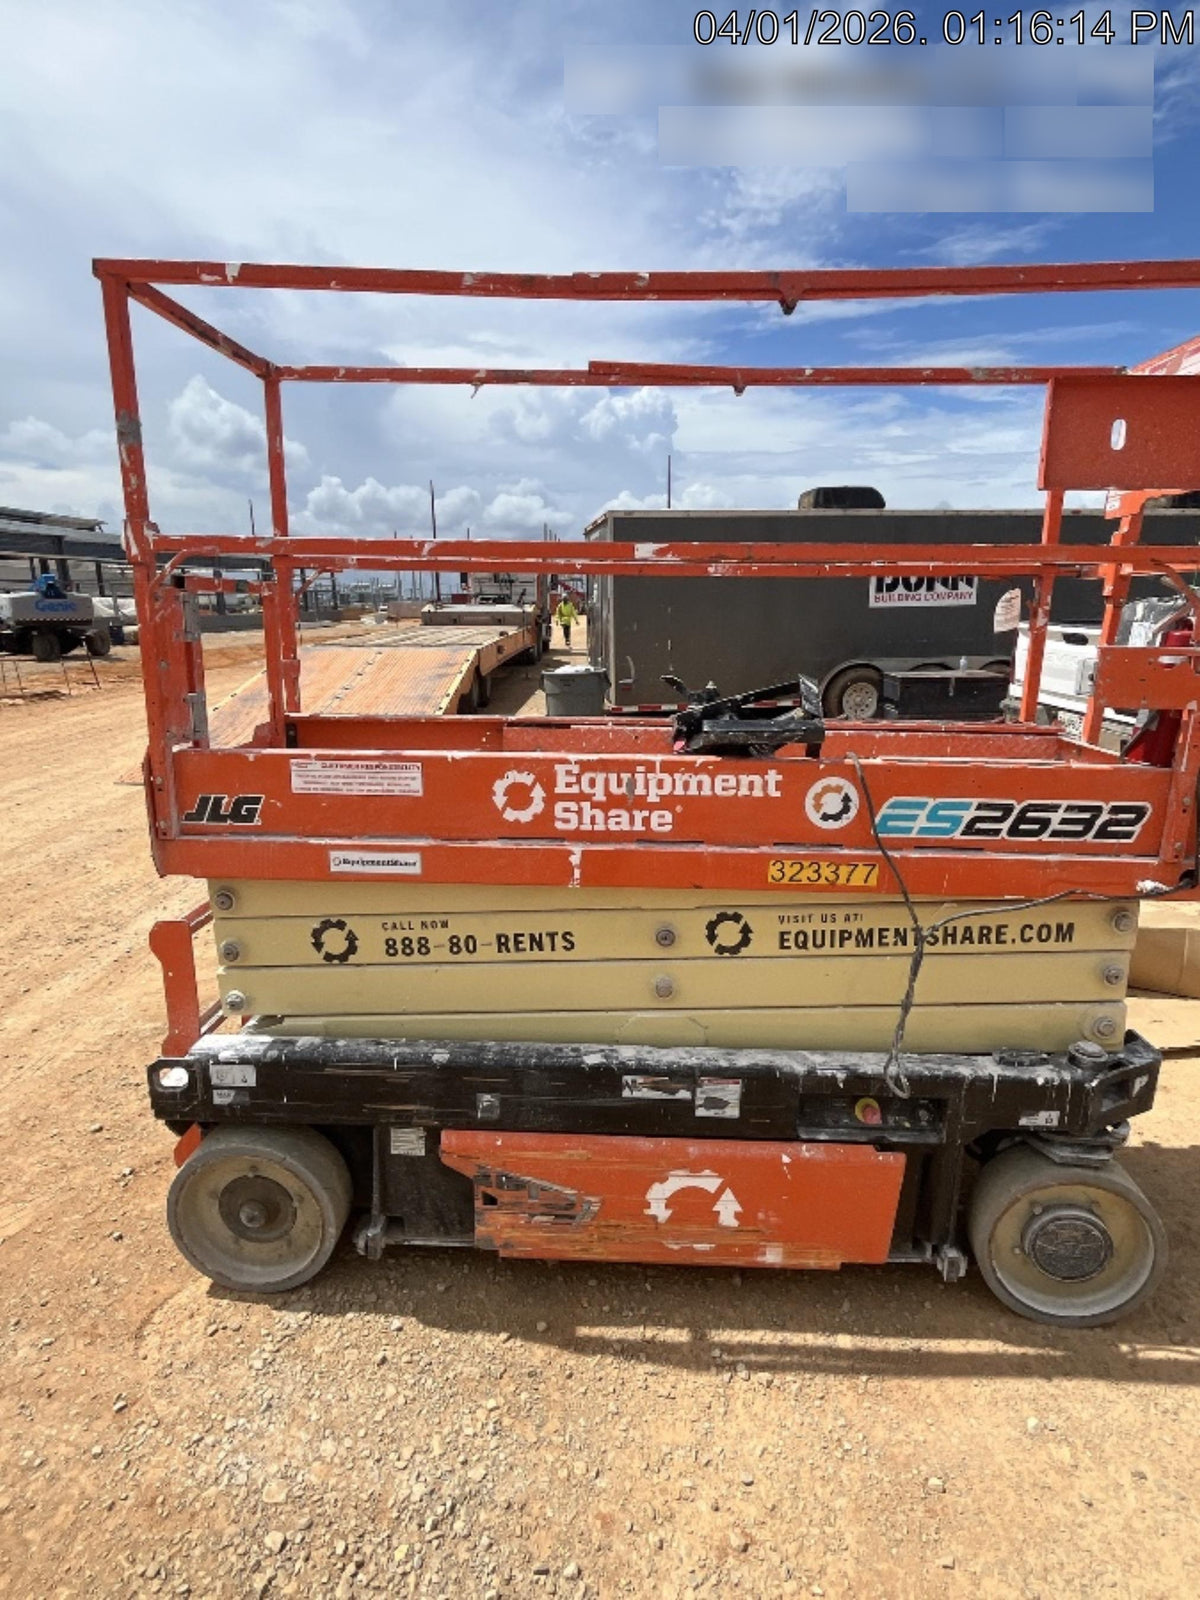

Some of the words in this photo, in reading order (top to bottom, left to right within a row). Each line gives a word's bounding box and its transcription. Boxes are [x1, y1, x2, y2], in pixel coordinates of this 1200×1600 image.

[874, 593, 921, 603] BUILDING
[924, 592, 973, 601] COMPANY
[554, 764, 783, 803] Equipment
[182, 795, 263, 825] JLG
[554, 801, 673, 832] Share
[874, 798, 1150, 841] ES2632
[769, 860, 879, 885] 323377
[381, 920, 414, 932] CALL
[420, 919, 449, 930] NOW
[778, 914, 814, 925] VISIT
[820, 913, 837, 924] US
[384, 931, 576, 957] 888-80-RENTS
[778, 922, 1075, 950] EQUIPMENTSHARE.COM
